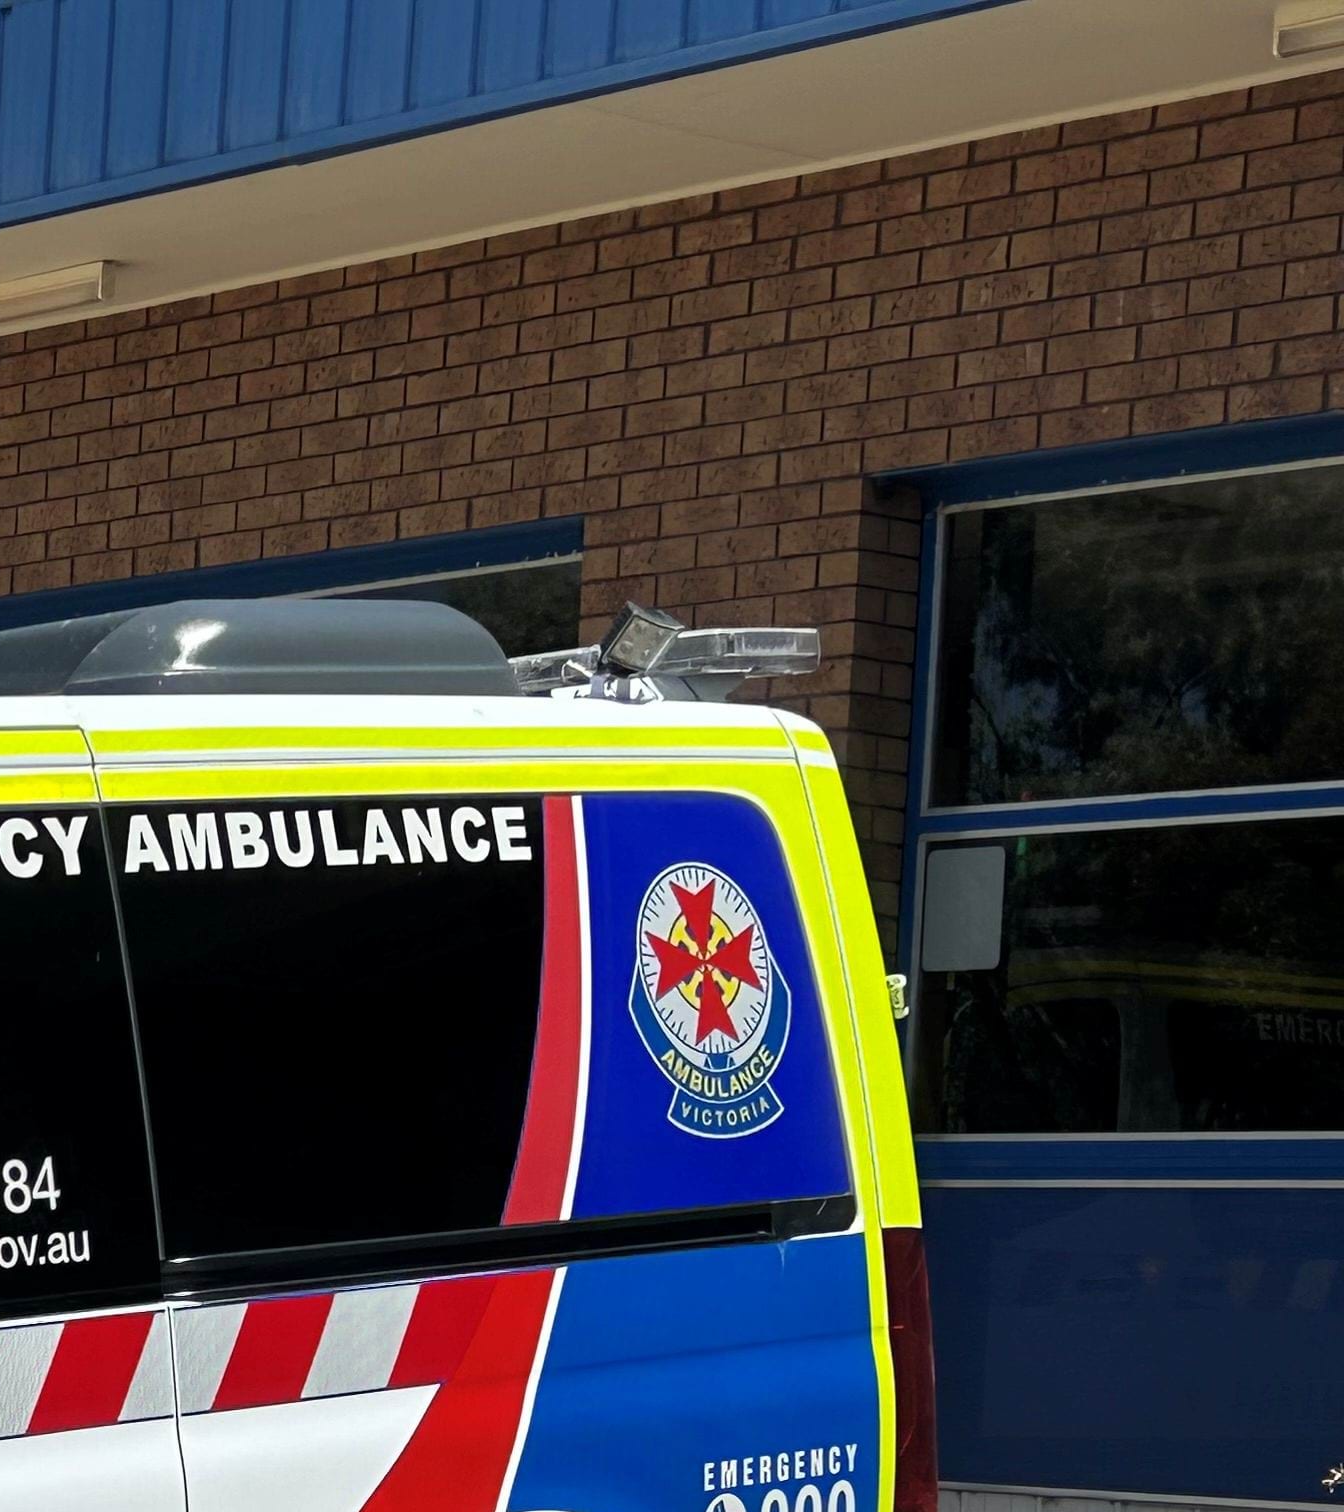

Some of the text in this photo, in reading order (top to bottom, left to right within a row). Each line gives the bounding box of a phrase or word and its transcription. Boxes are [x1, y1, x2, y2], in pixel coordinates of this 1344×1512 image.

[123, 806, 533, 874] AMBULANCE
[660, 1043, 775, 1098] AMBULANCE
[680, 1095, 770, 1127] VICTORIA
[1, 1155, 62, 1214] 84
[702, 1442, 859, 1492] EMERGENCY
